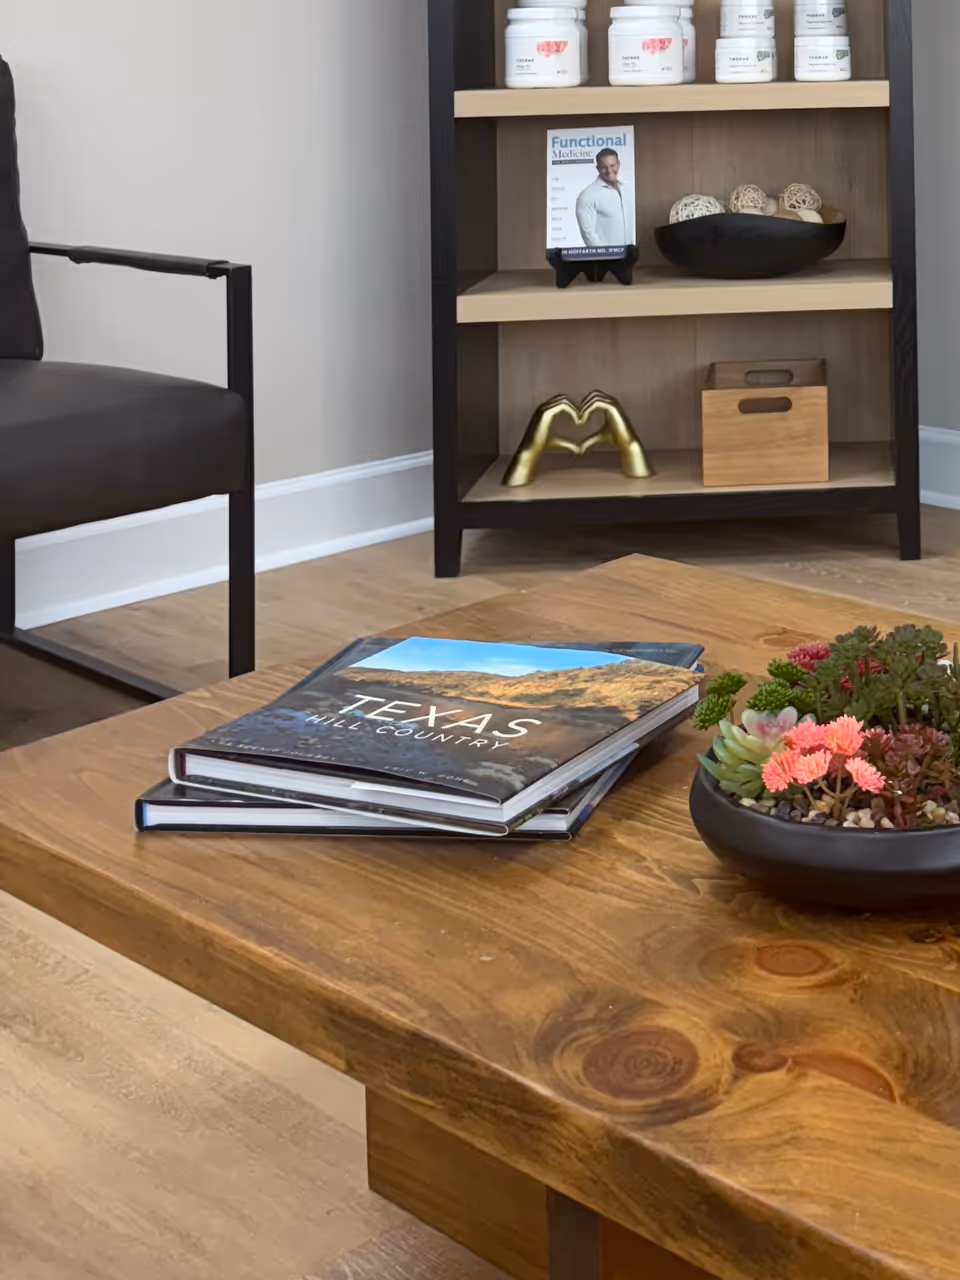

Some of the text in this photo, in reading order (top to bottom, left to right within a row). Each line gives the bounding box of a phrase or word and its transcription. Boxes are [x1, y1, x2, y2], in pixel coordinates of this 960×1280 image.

[551, 132, 627, 149] Functional
[551, 149, 593, 159] Medicine
[338, 693, 543, 739] TEXAS
[304, 713, 511, 752] HILL COUNTRY
